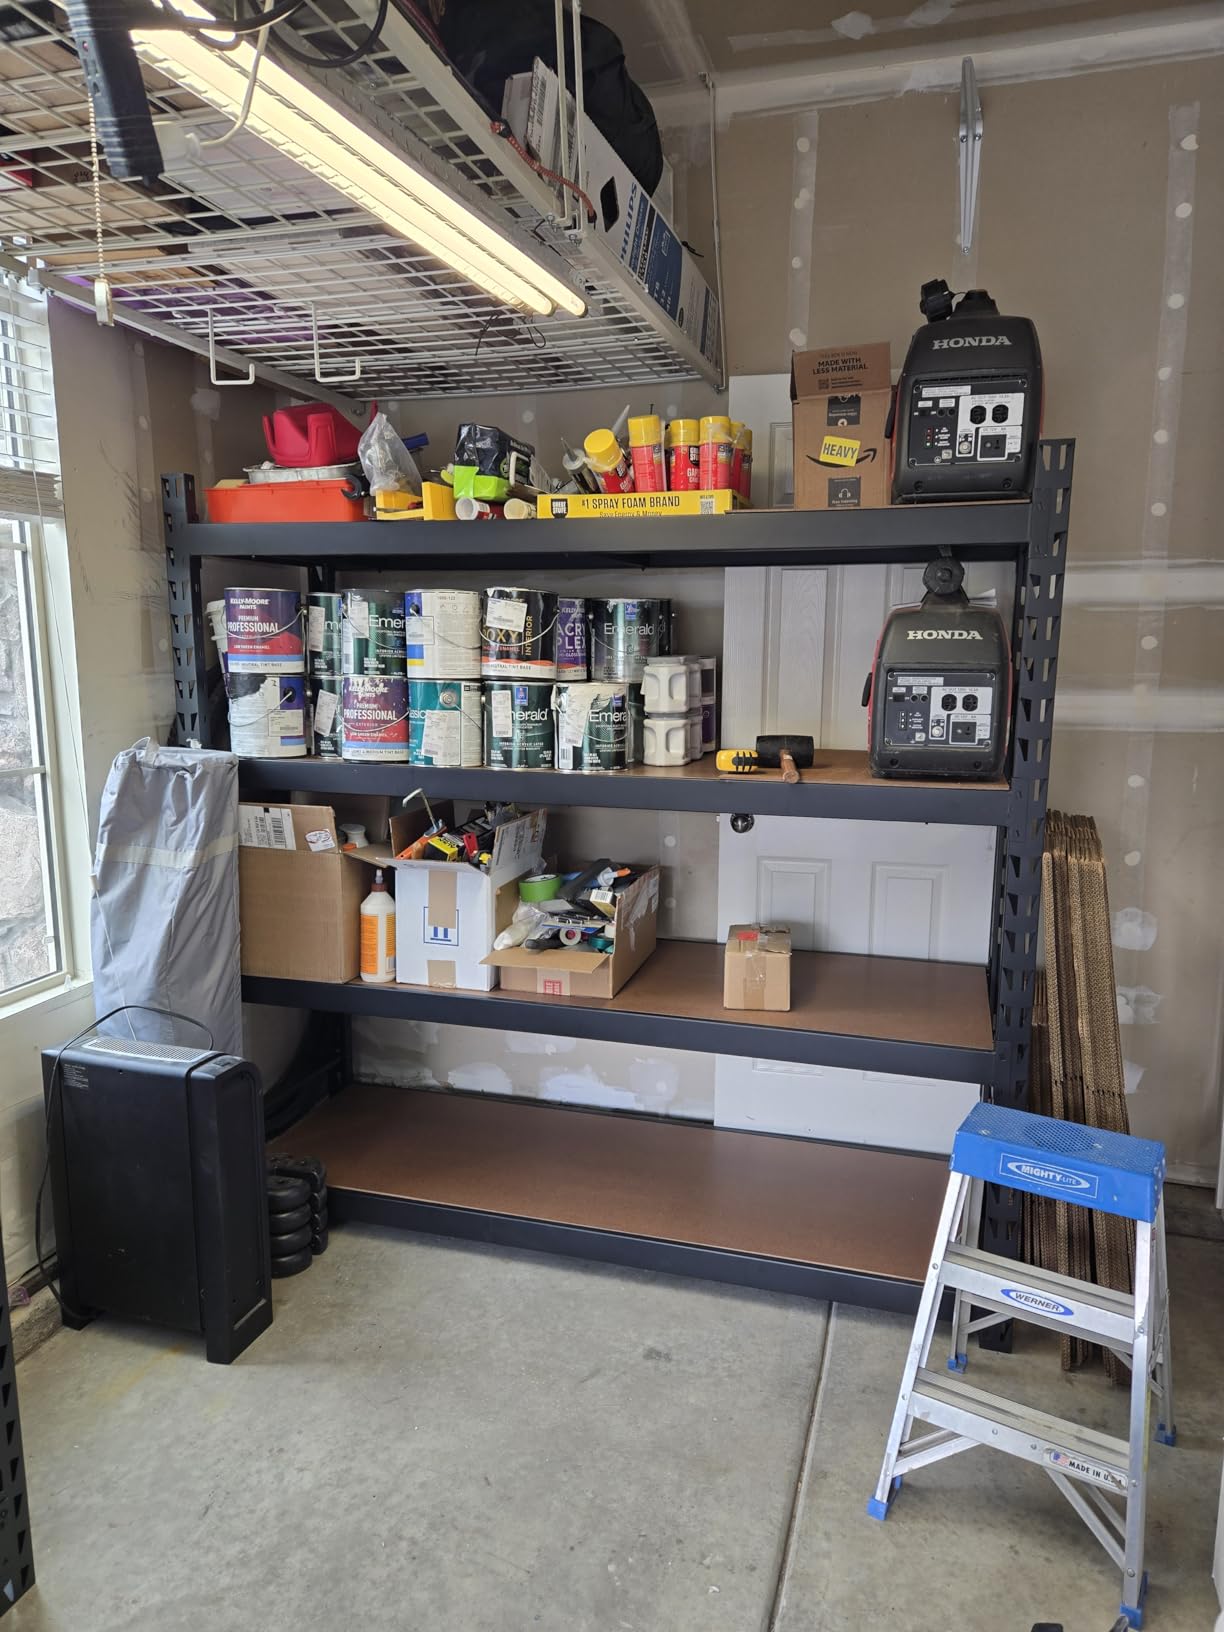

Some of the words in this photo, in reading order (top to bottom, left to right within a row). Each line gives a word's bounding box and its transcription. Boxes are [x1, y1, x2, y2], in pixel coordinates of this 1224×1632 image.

[932, 335, 1012, 350] HONDA
[812, 367, 830, 375] LESS
[831, 363, 869, 373] MATERIAL
[817, 359, 840, 368] MADE
[840, 357, 862, 365] WITH
[822, 442, 858, 460] HEAVY
[581, 498, 590, 509] #1
[592, 498, 619, 509] SPRAY
[622, 497, 647, 508] FOAM
[649, 495, 680, 508] BRAND
[227, 621, 279, 633] PROFESSIONAL
[369, 614, 405, 629] Emer
[525, 615, 533, 656] INTERIOR
[604, 622, 655, 636] Emerald
[906, 629, 984, 641] HONDA
[344, 709, 398, 720] PROFESSIONAL
[589, 709, 628, 722] Emera
[1015, 1292, 1060, 1312] WERNER
[1068, 1461, 1090, 1474] MADE
[1092, 1469, 1102, 1478] IN
